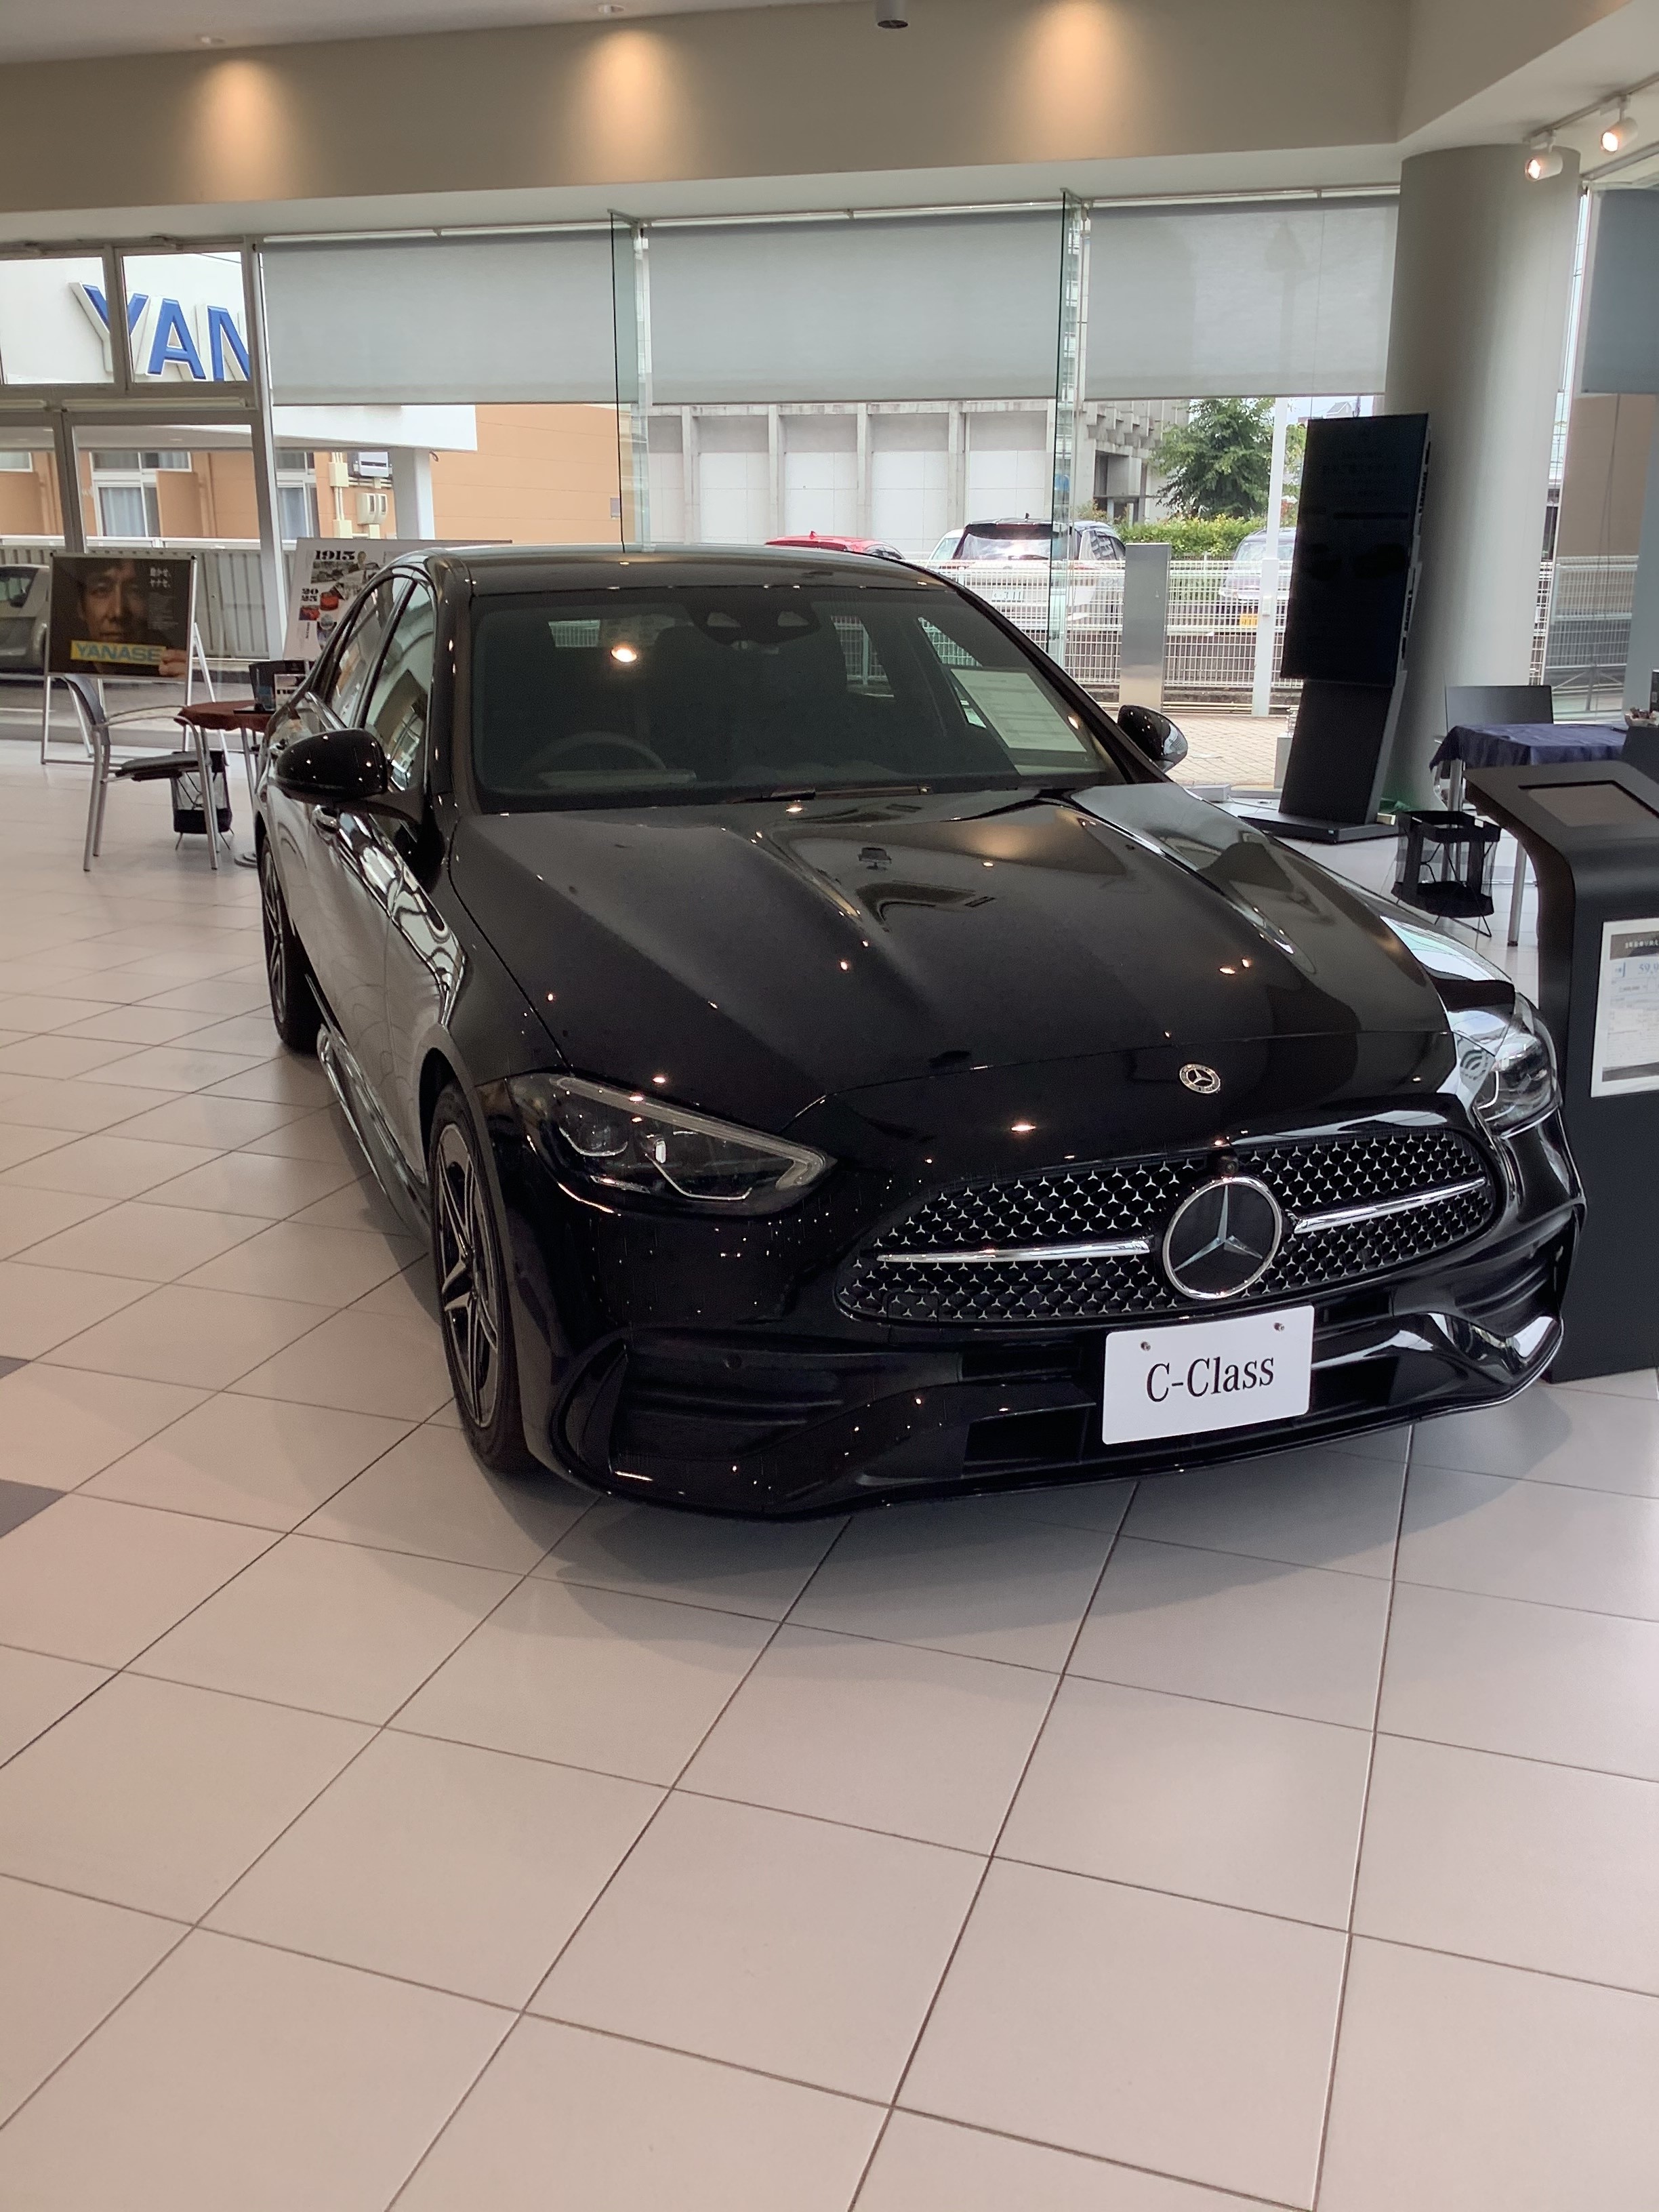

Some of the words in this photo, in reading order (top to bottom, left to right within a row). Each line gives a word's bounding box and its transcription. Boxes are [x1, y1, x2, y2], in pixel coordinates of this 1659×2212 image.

[315, 550, 355, 560] 1915
[75, 644, 163, 662] YANASE
[1146, 1356, 1275, 1403] C-Class
